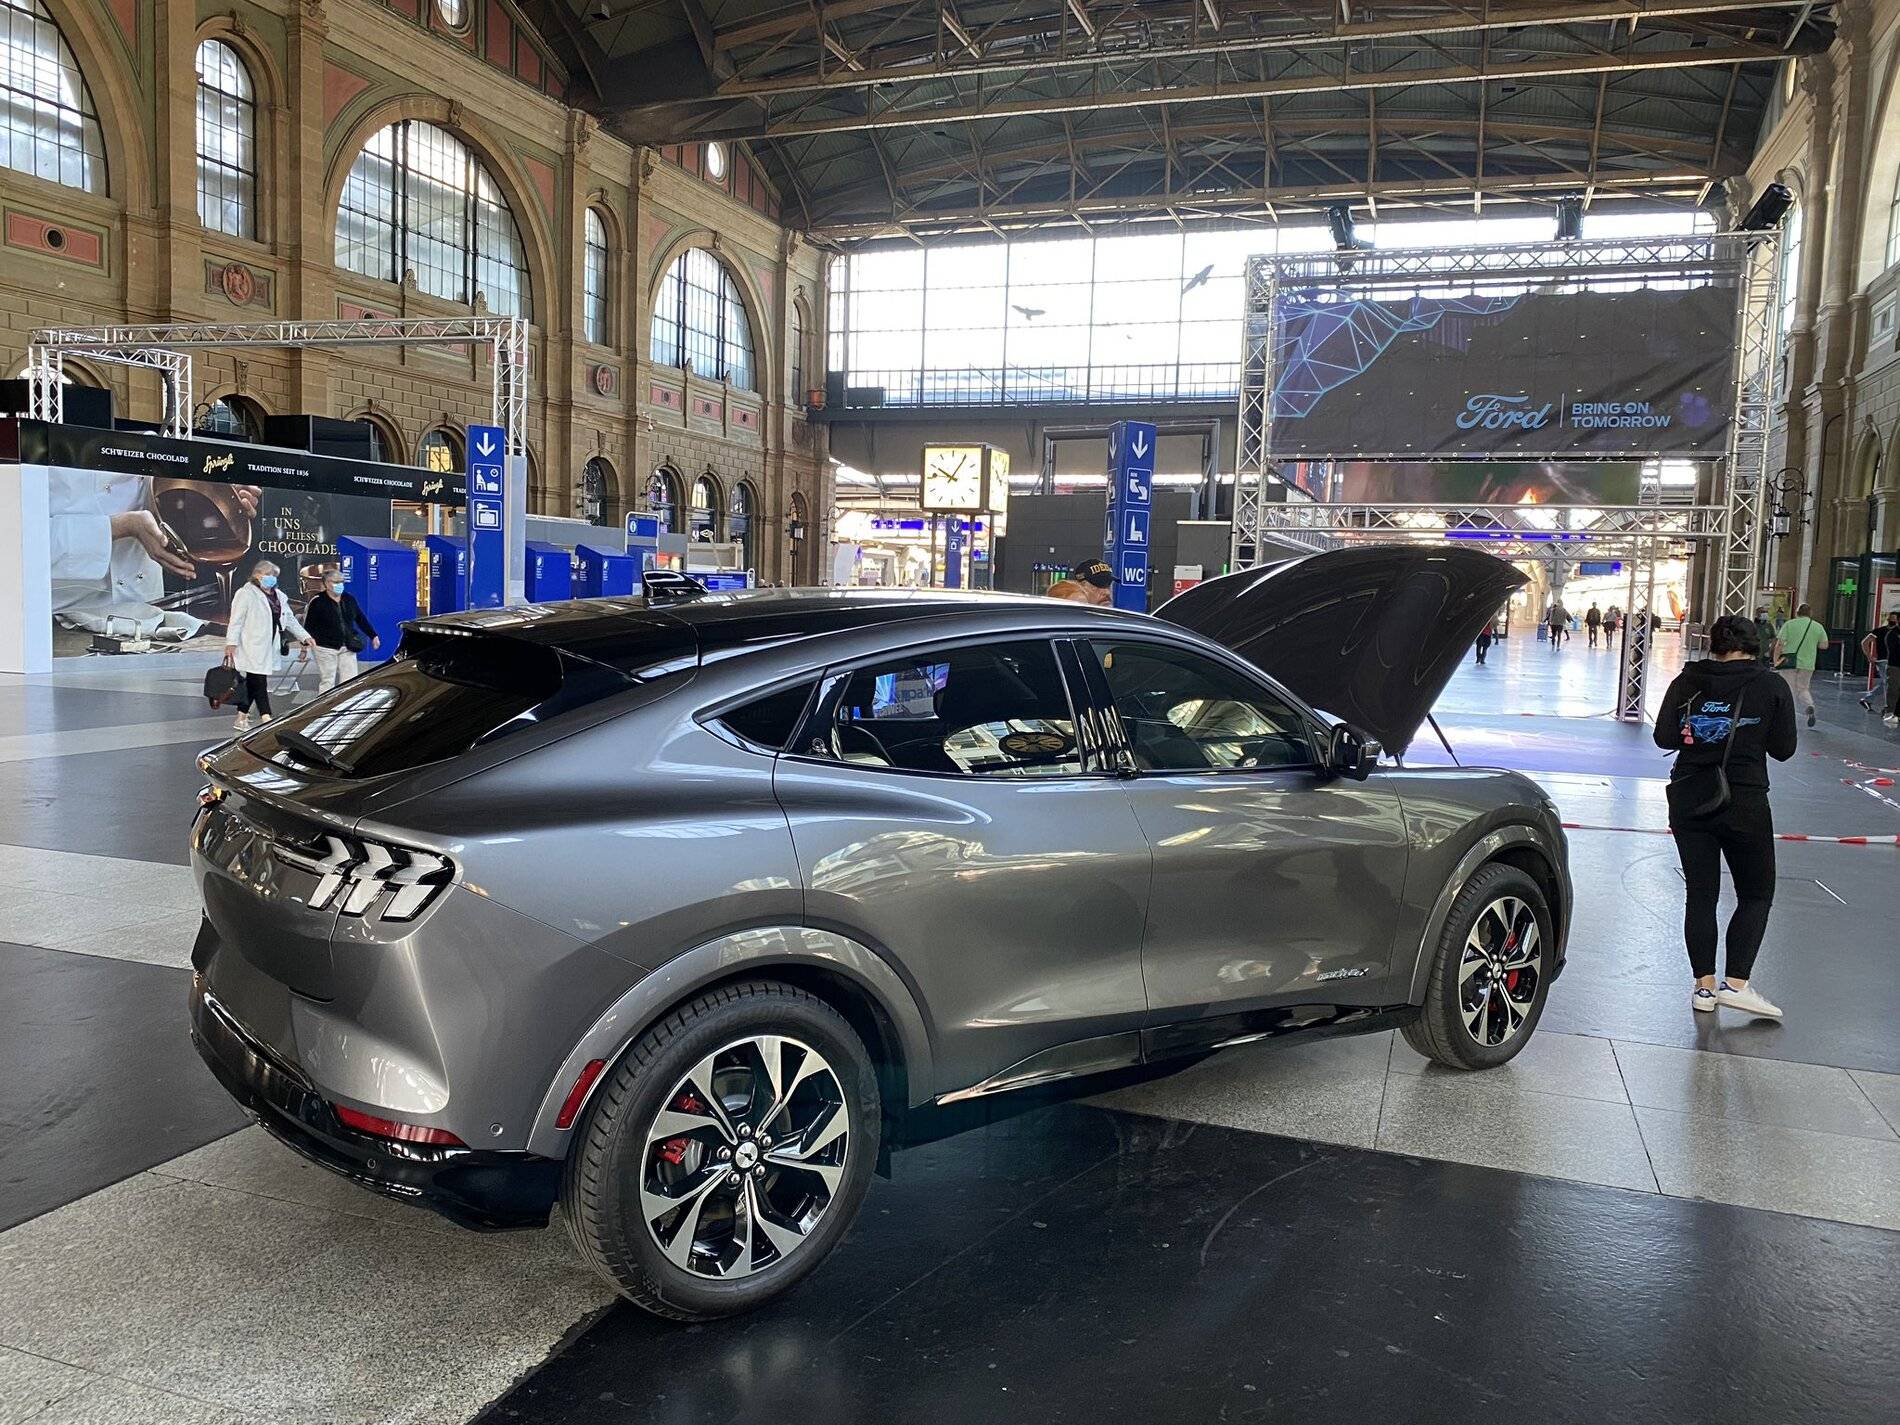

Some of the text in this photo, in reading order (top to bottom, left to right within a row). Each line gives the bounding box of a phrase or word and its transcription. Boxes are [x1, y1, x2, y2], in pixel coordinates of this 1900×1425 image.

[1455, 394, 1552, 429] Ford
[1572, 402, 1650, 415] BRING ON
[1571, 415, 1671, 428] TOMORROW
[101, 447, 189, 464] SCHWEIZER CHOCOLADE
[248, 463, 282, 474] TRADITION
[282, 467, 296, 475] SEIT
[281, 507, 293, 516] IN
[274, 517, 301, 530] UNS
[1124, 567, 1145, 582] WC
[1701, 701, 1731, 713] Ford
